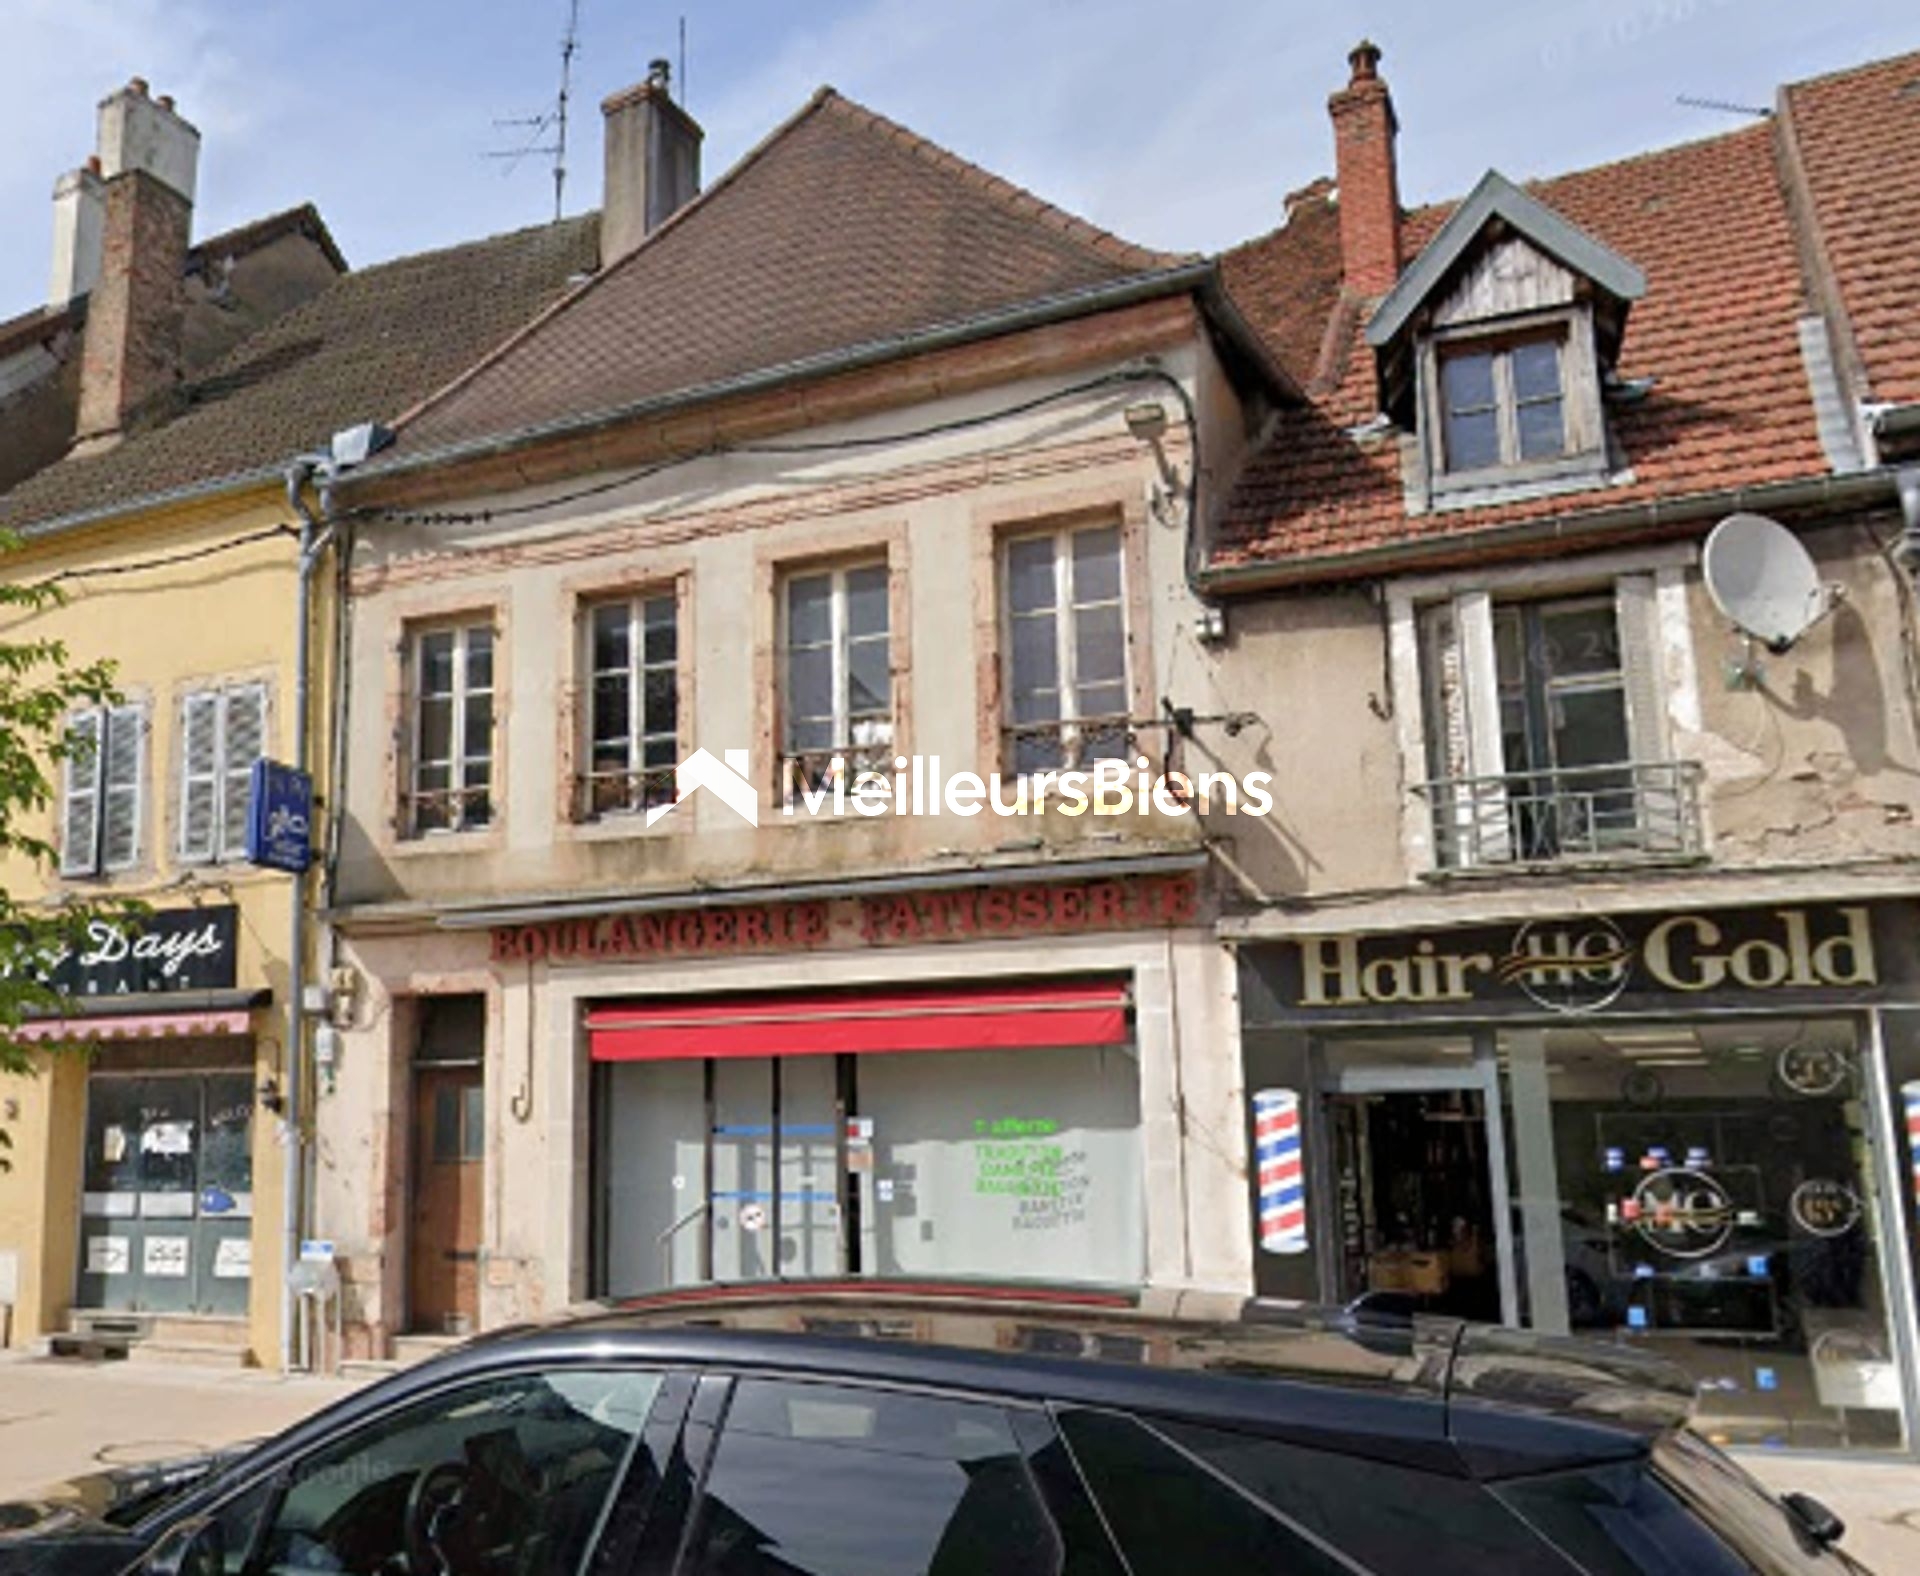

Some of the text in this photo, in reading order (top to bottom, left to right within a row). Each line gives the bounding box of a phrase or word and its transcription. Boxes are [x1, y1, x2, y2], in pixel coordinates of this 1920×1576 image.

[860, 876, 1197, 942] PATISSERIE
[79, 919, 223, 977] Days
[1300, 936, 1492, 1005] Hair
[1644, 907, 1877, 989] Gold
